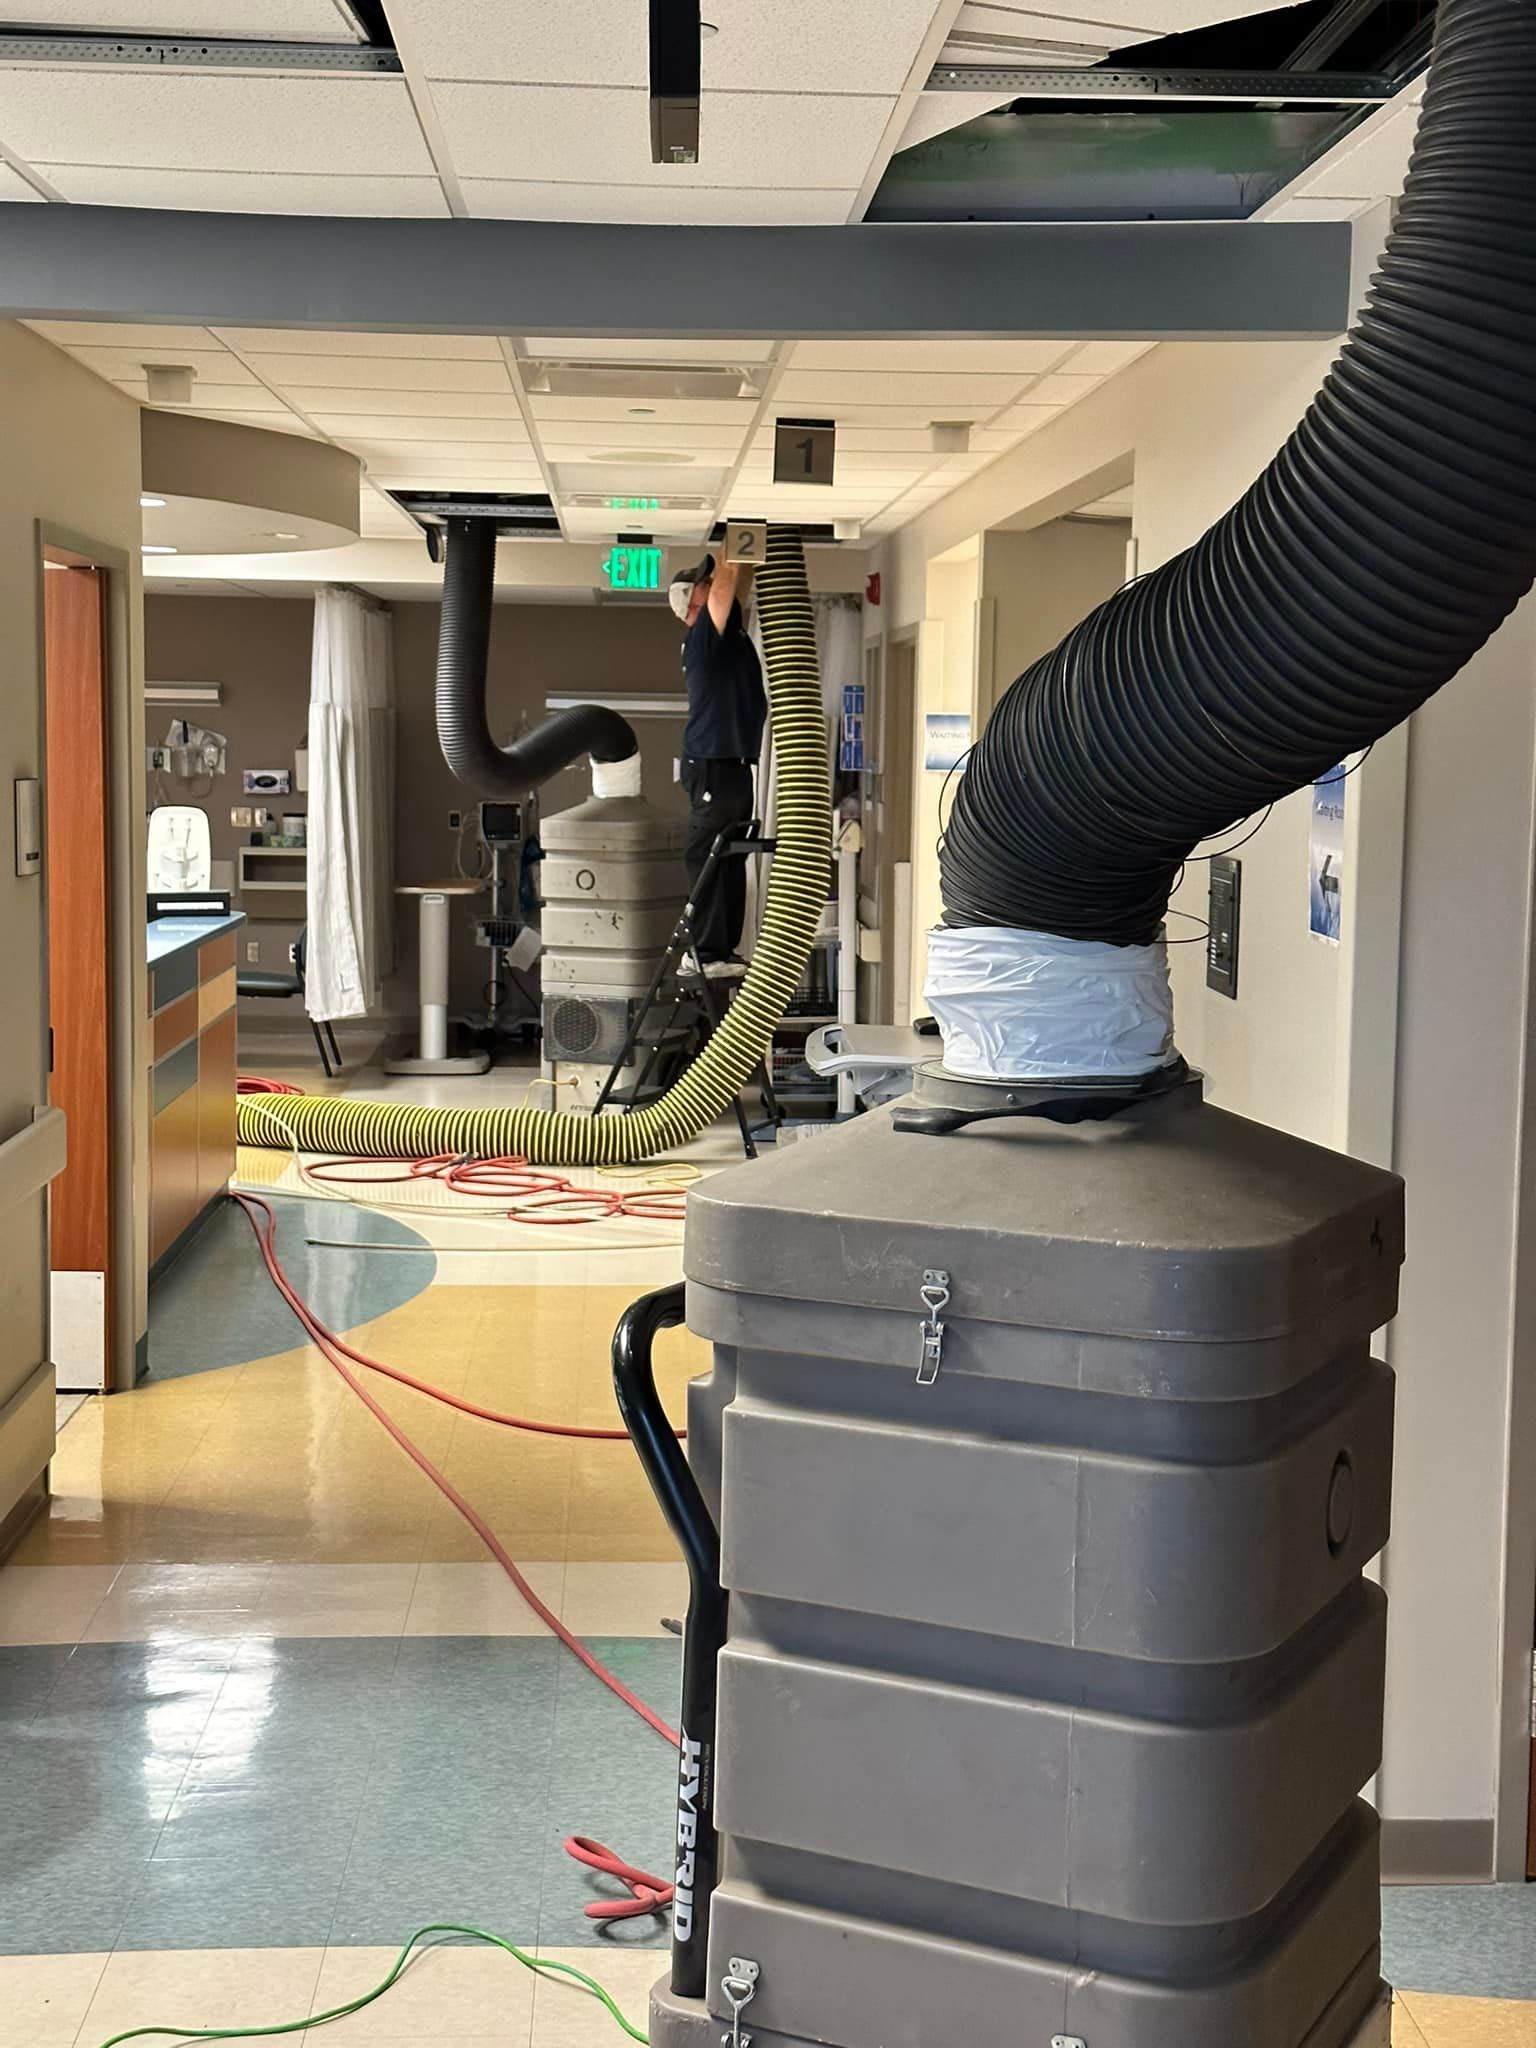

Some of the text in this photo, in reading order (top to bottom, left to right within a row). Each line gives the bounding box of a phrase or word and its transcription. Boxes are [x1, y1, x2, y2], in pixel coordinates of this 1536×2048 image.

[796, 437, 816, 474] 1
[737, 530, 756, 557] 2
[610, 547, 662, 588] EXIT
[674, 1726, 702, 1942] HYBRID
